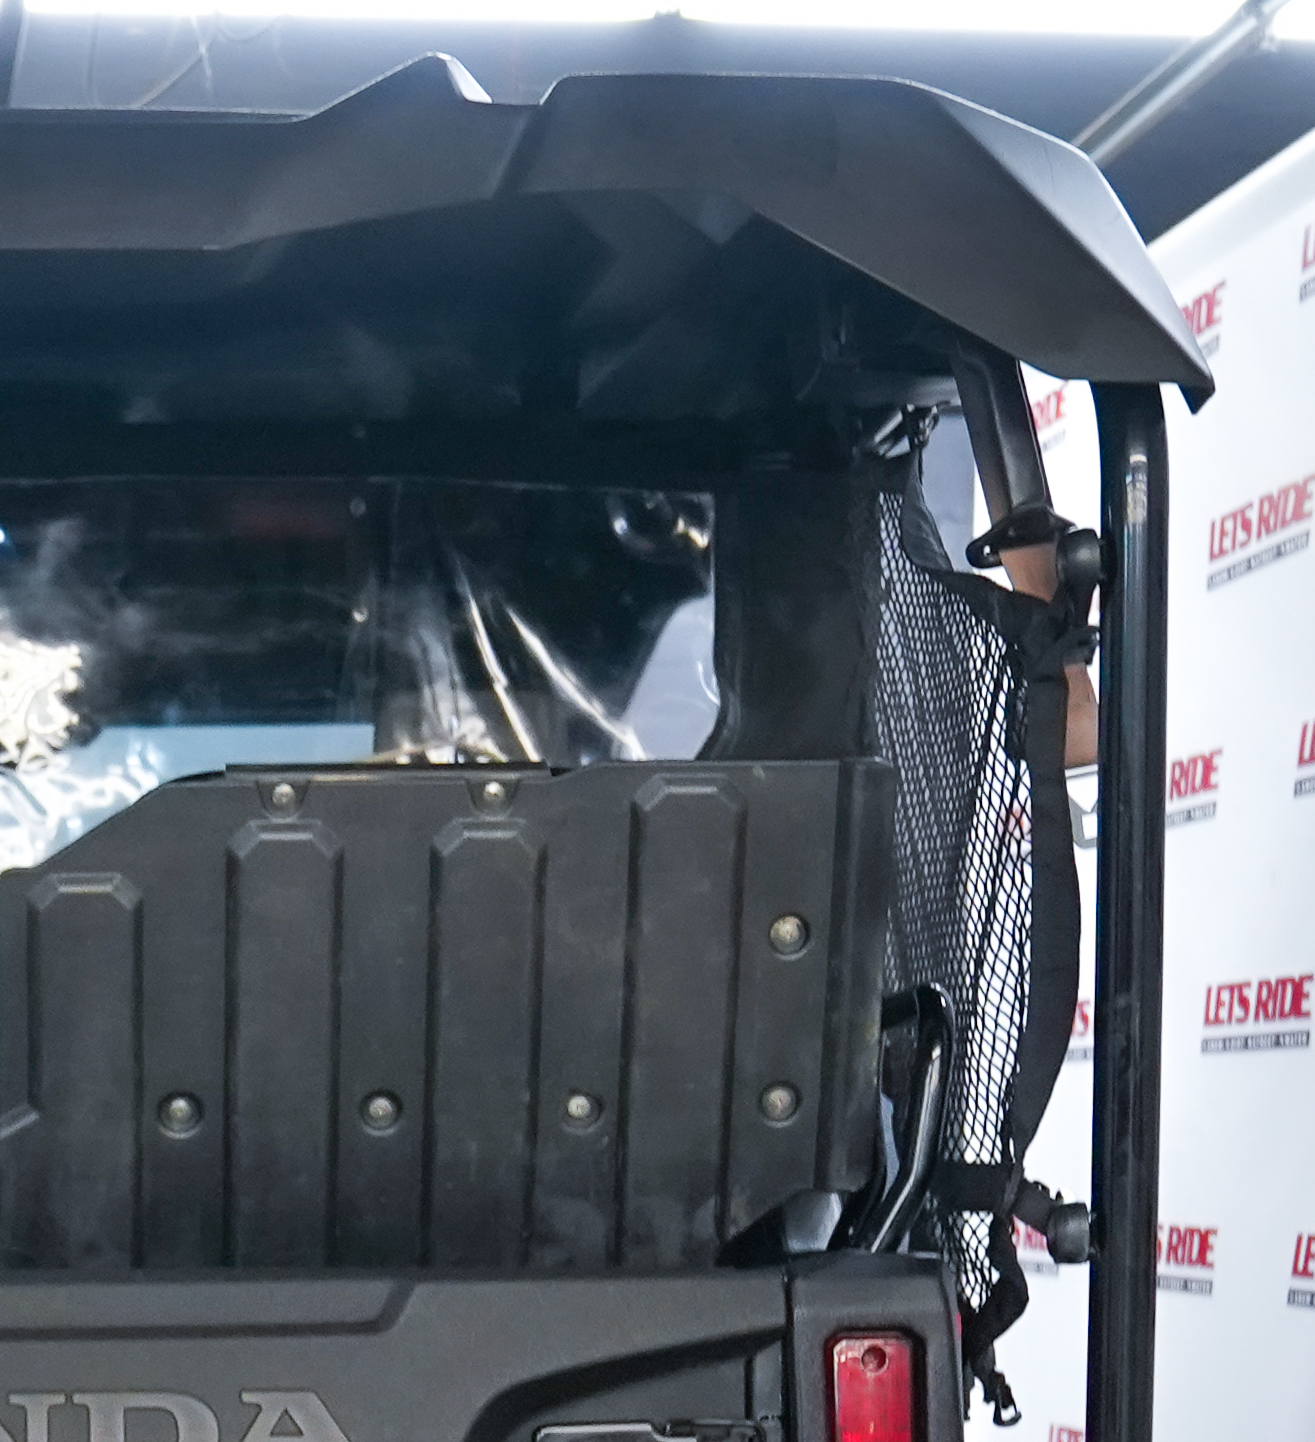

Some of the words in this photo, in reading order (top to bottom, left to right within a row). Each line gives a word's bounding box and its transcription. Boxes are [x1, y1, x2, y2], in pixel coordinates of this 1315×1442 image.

[1257, 474, 1315, 540] RIDE
[1169, 747, 1223, 802] RIDE
[1254, 974, 1314, 1023] RIDE
[1166, 1224, 1218, 1268] RIDE
[1291, 1232, 1315, 1278] LE
